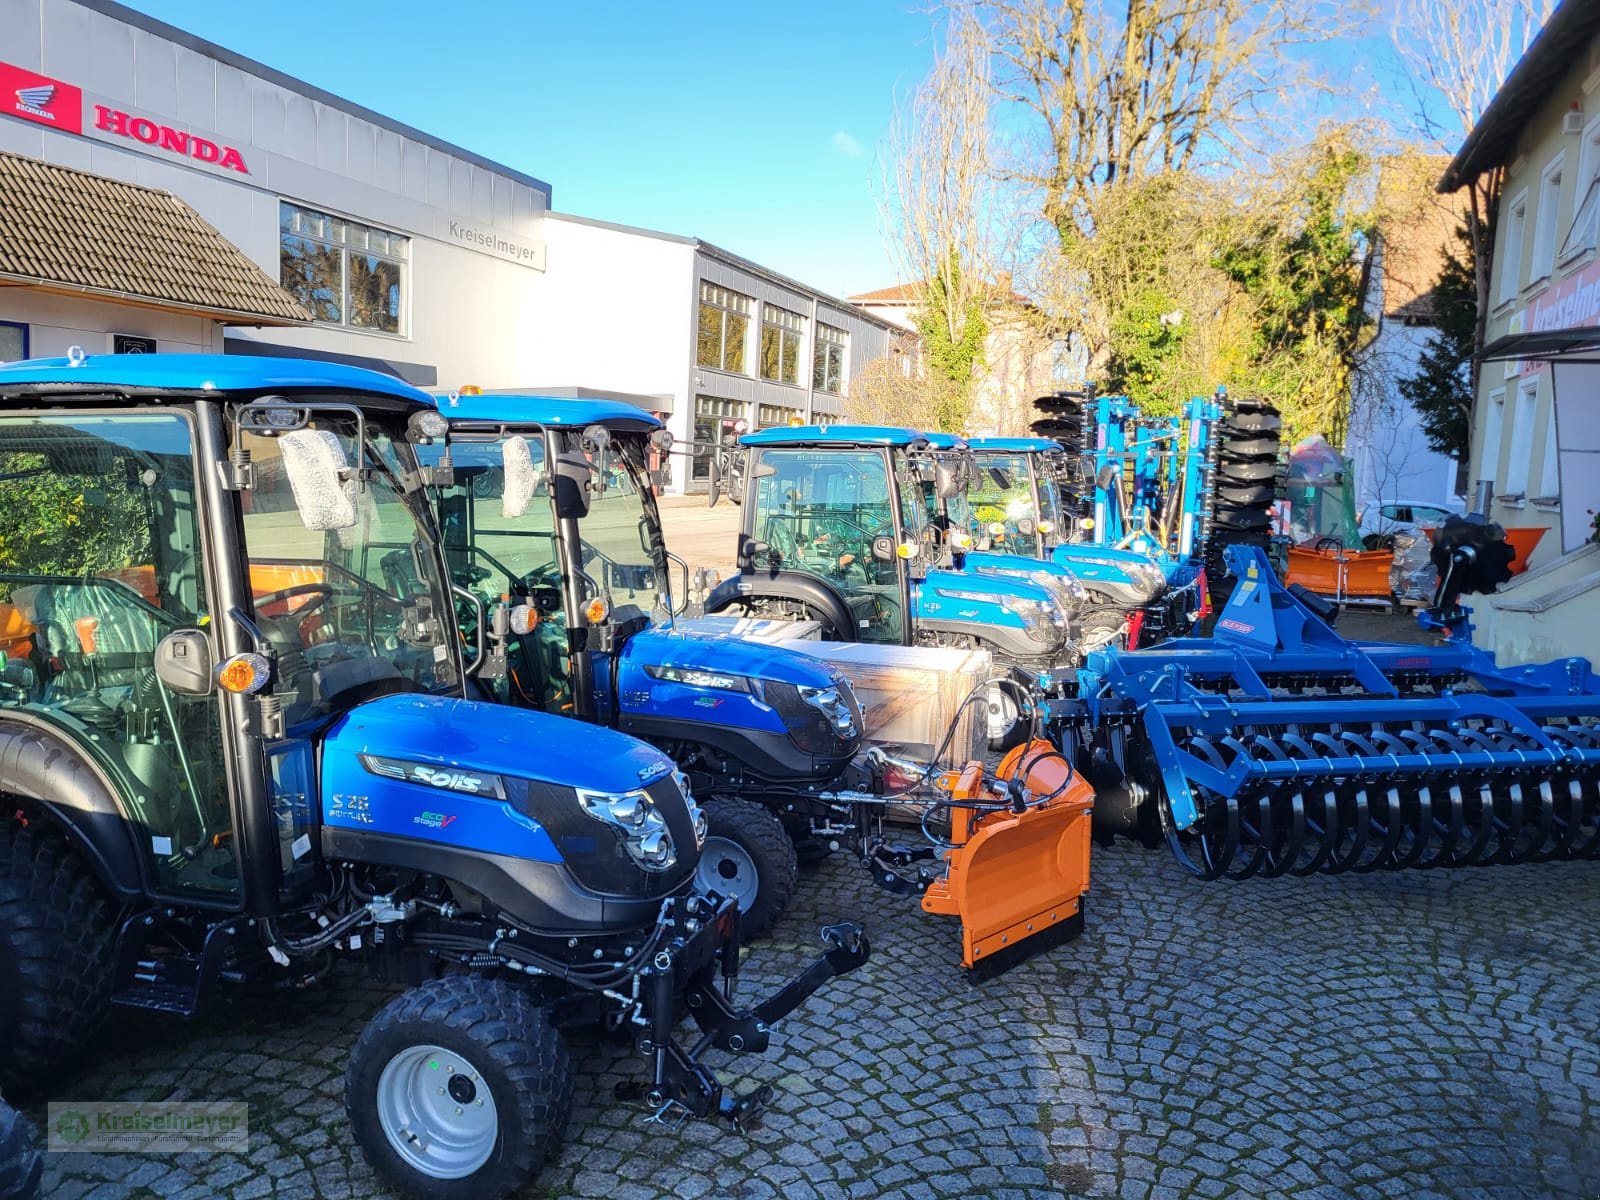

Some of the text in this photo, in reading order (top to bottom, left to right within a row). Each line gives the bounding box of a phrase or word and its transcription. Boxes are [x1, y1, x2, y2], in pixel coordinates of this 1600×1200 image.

[15, 102, 56, 120] HONDA
[94, 104, 250, 175] HONDA
[449, 220, 536, 261] Kreiselmeyer
